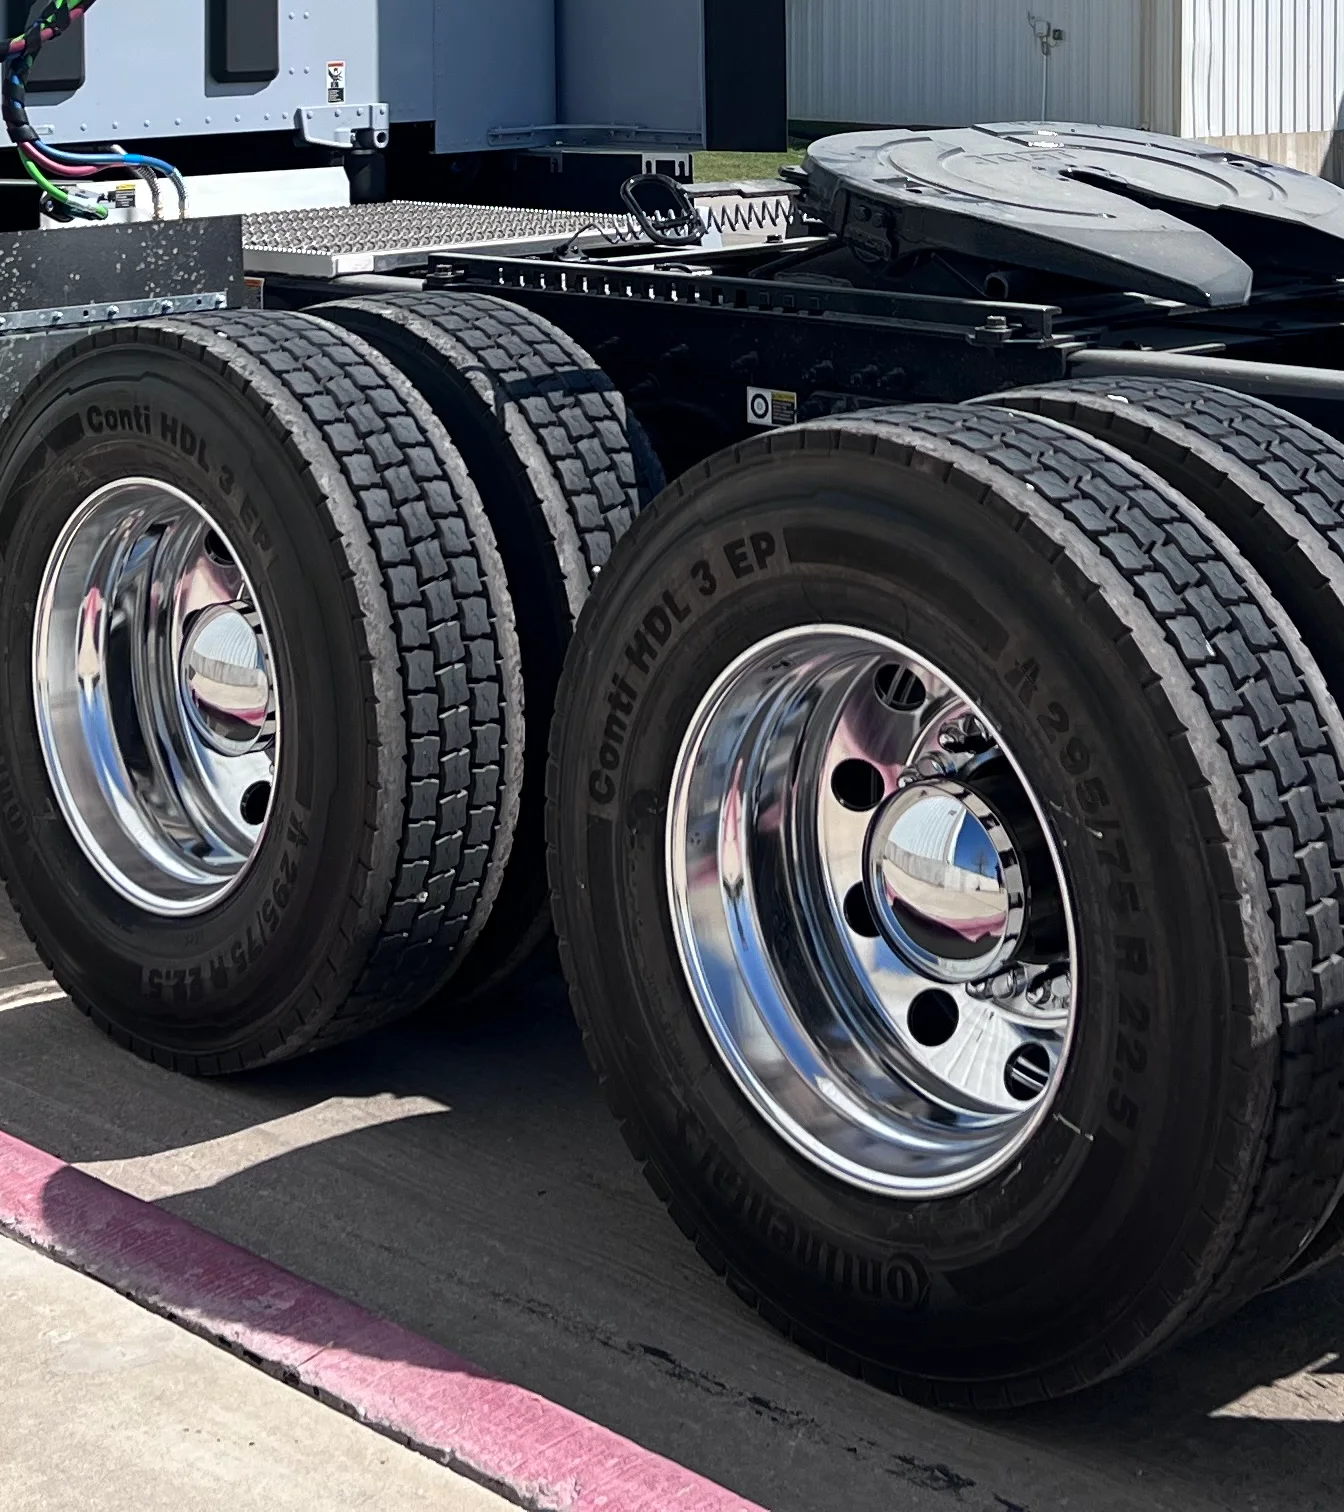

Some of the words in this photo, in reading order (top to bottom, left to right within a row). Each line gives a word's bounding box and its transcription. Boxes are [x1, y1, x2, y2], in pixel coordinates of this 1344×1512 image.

[87, 404, 150, 435] Conti
[160, 411, 209, 473] HDL
[219, 464, 235, 495] 3
[239, 494, 272, 553] EP
[589, 674, 637, 805] Conti
[625, 589, 692, 675] HDL
[691, 560, 717, 596] 3
[723, 531, 776, 580] EP
